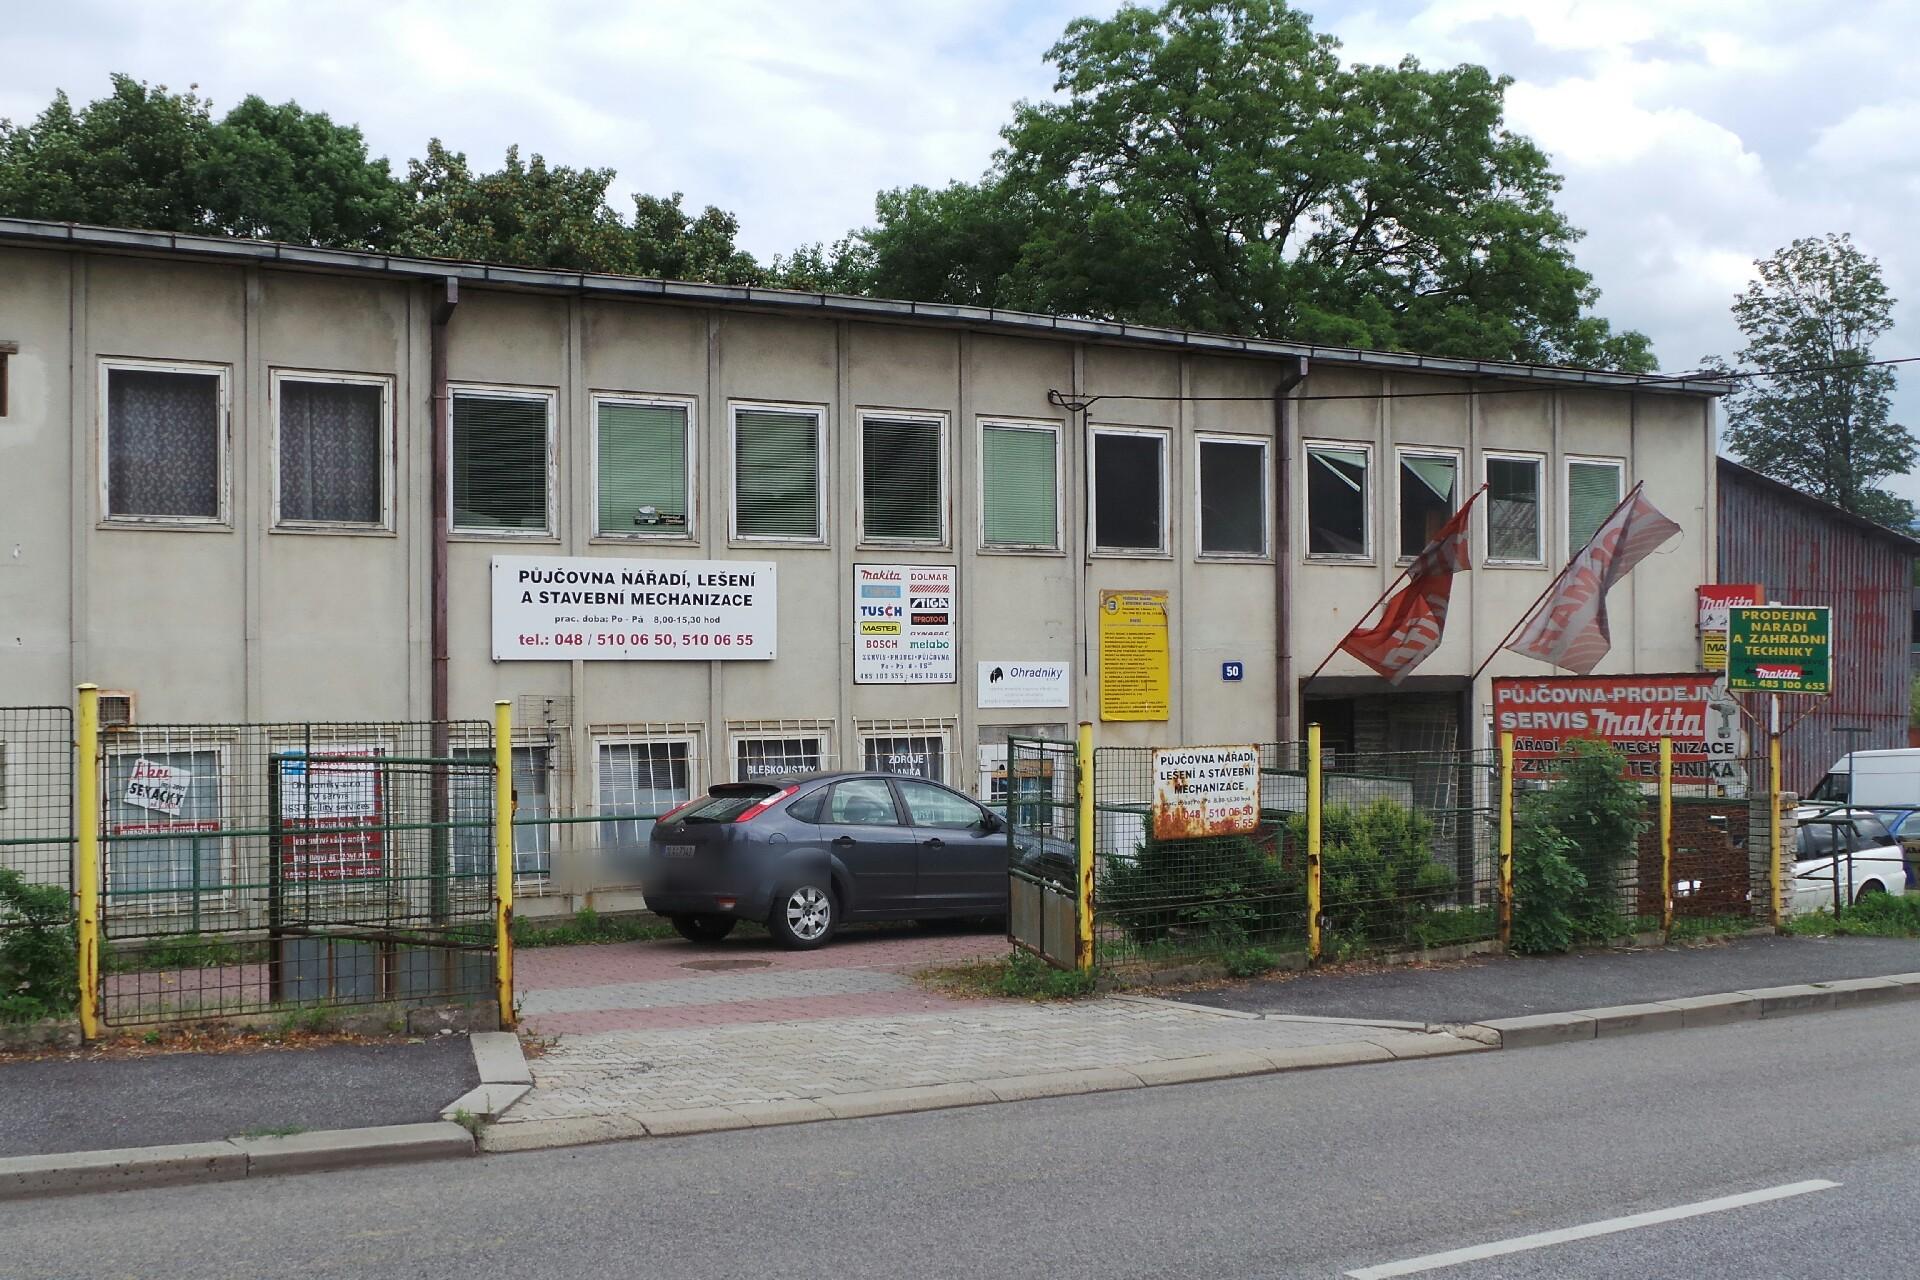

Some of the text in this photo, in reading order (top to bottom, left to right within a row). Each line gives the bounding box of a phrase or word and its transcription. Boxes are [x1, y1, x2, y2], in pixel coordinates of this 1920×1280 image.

[519, 567, 756, 588] PŮJČOVNA NÁŘADÍ, LEŠENÍ
[911, 573, 948, 581] DOLMAR
[521, 589, 753, 607] A STAVEBNÍ MECHANIZACE
[860, 605, 903, 617] TUSCH
[1742, 610, 1817, 621] PRODEJNA
[554, 615, 579, 624] prac.
[582, 615, 609, 623] doba:
[611, 615, 623, 623] Po
[653, 615, 701, 625] 8,00-15,30
[703, 615, 721, 624] hod
[518, 633, 549, 646] tel.:
[554, 633, 583, 646] 048
[597, 633, 625, 646] 510
[630, 633, 649, 646] 06
[654, 633, 676, 648] 50,
[682, 633, 709, 646] 510
[713, 634, 731, 646] 06
[736, 634, 754, 646] 55
[866, 640, 898, 649] BOSCH
[1733, 634, 1743, 643] A
[1745, 646, 1814, 656] TECHNIKY
[1226, 665, 1239, 677] 50
[1759, 679, 1779, 688] 485
[1782, 679, 1802, 688] 100
[1805, 682, 1825, 690] 655
[1500, 711, 1589, 731] SERVIS
[1613, 741, 1735, 755] MECHNIZACE
[888, 754, 924, 764] ZDROJE
[1160, 753, 1215, 766] PŮJČOVNA
[1160, 768, 1196, 781] LEŠENÍ
[1199, 769, 1205, 779] A
[1174, 781, 1245, 794] MECHANIZACE
[1183, 809, 1201, 820] 048
[1209, 808, 1226, 818] 510
[1242, 806, 1254, 816] 50
